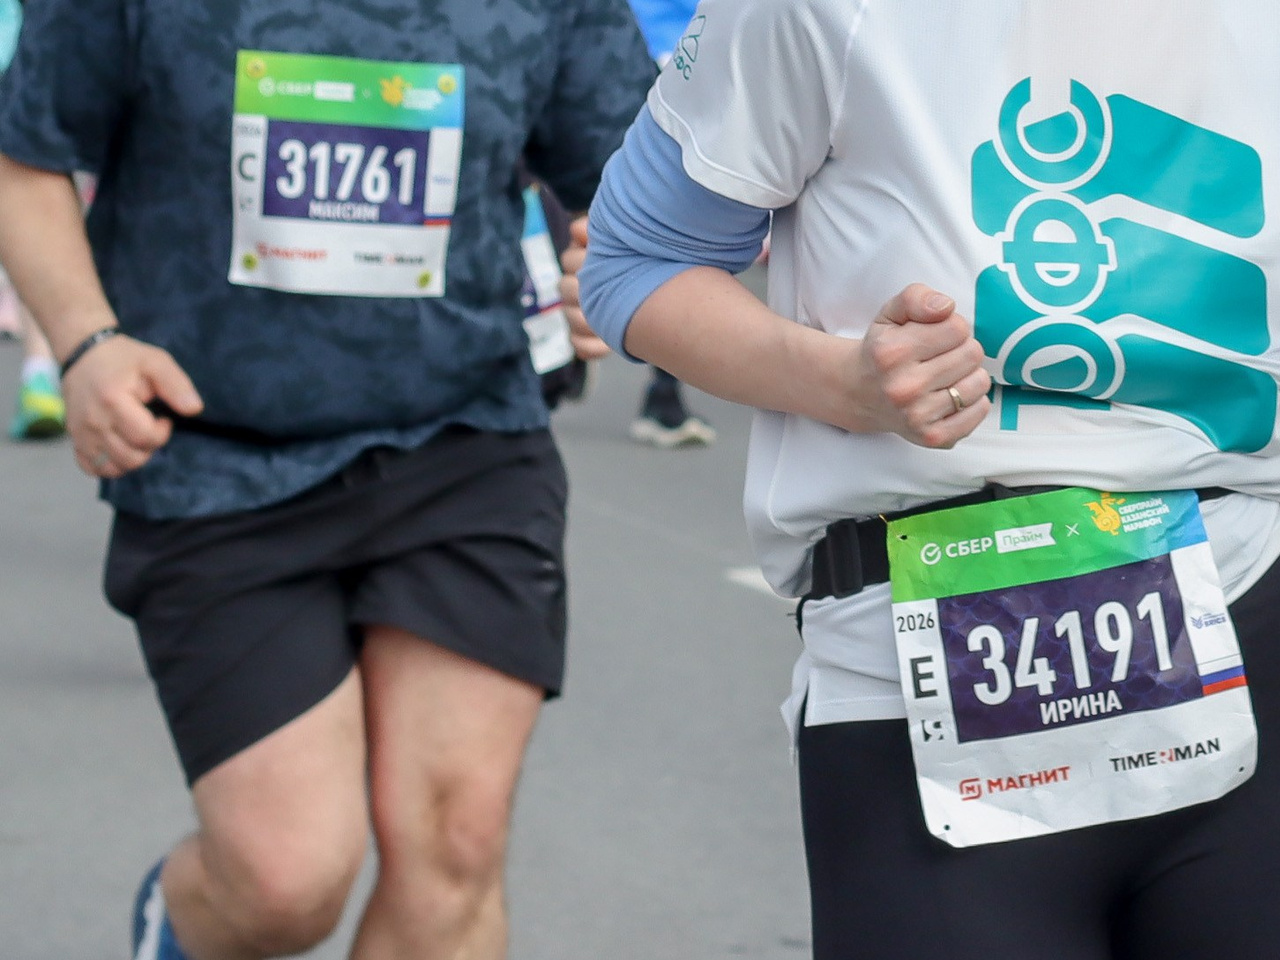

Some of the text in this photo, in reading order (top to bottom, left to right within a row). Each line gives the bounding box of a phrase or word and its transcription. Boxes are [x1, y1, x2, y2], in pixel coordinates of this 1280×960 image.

[277, 139, 416, 205] 31761
[945, 536, 994, 558] СБЕР
[1002, 530, 1044, 547] Прайм
[896, 611, 935, 633] 2026
[967, 591, 1173, 706] 34191
[909, 654, 938, 699] E
[1038, 690, 1123, 726] ИРИНА
[986, 765, 1071, 795] МАГНИТ
